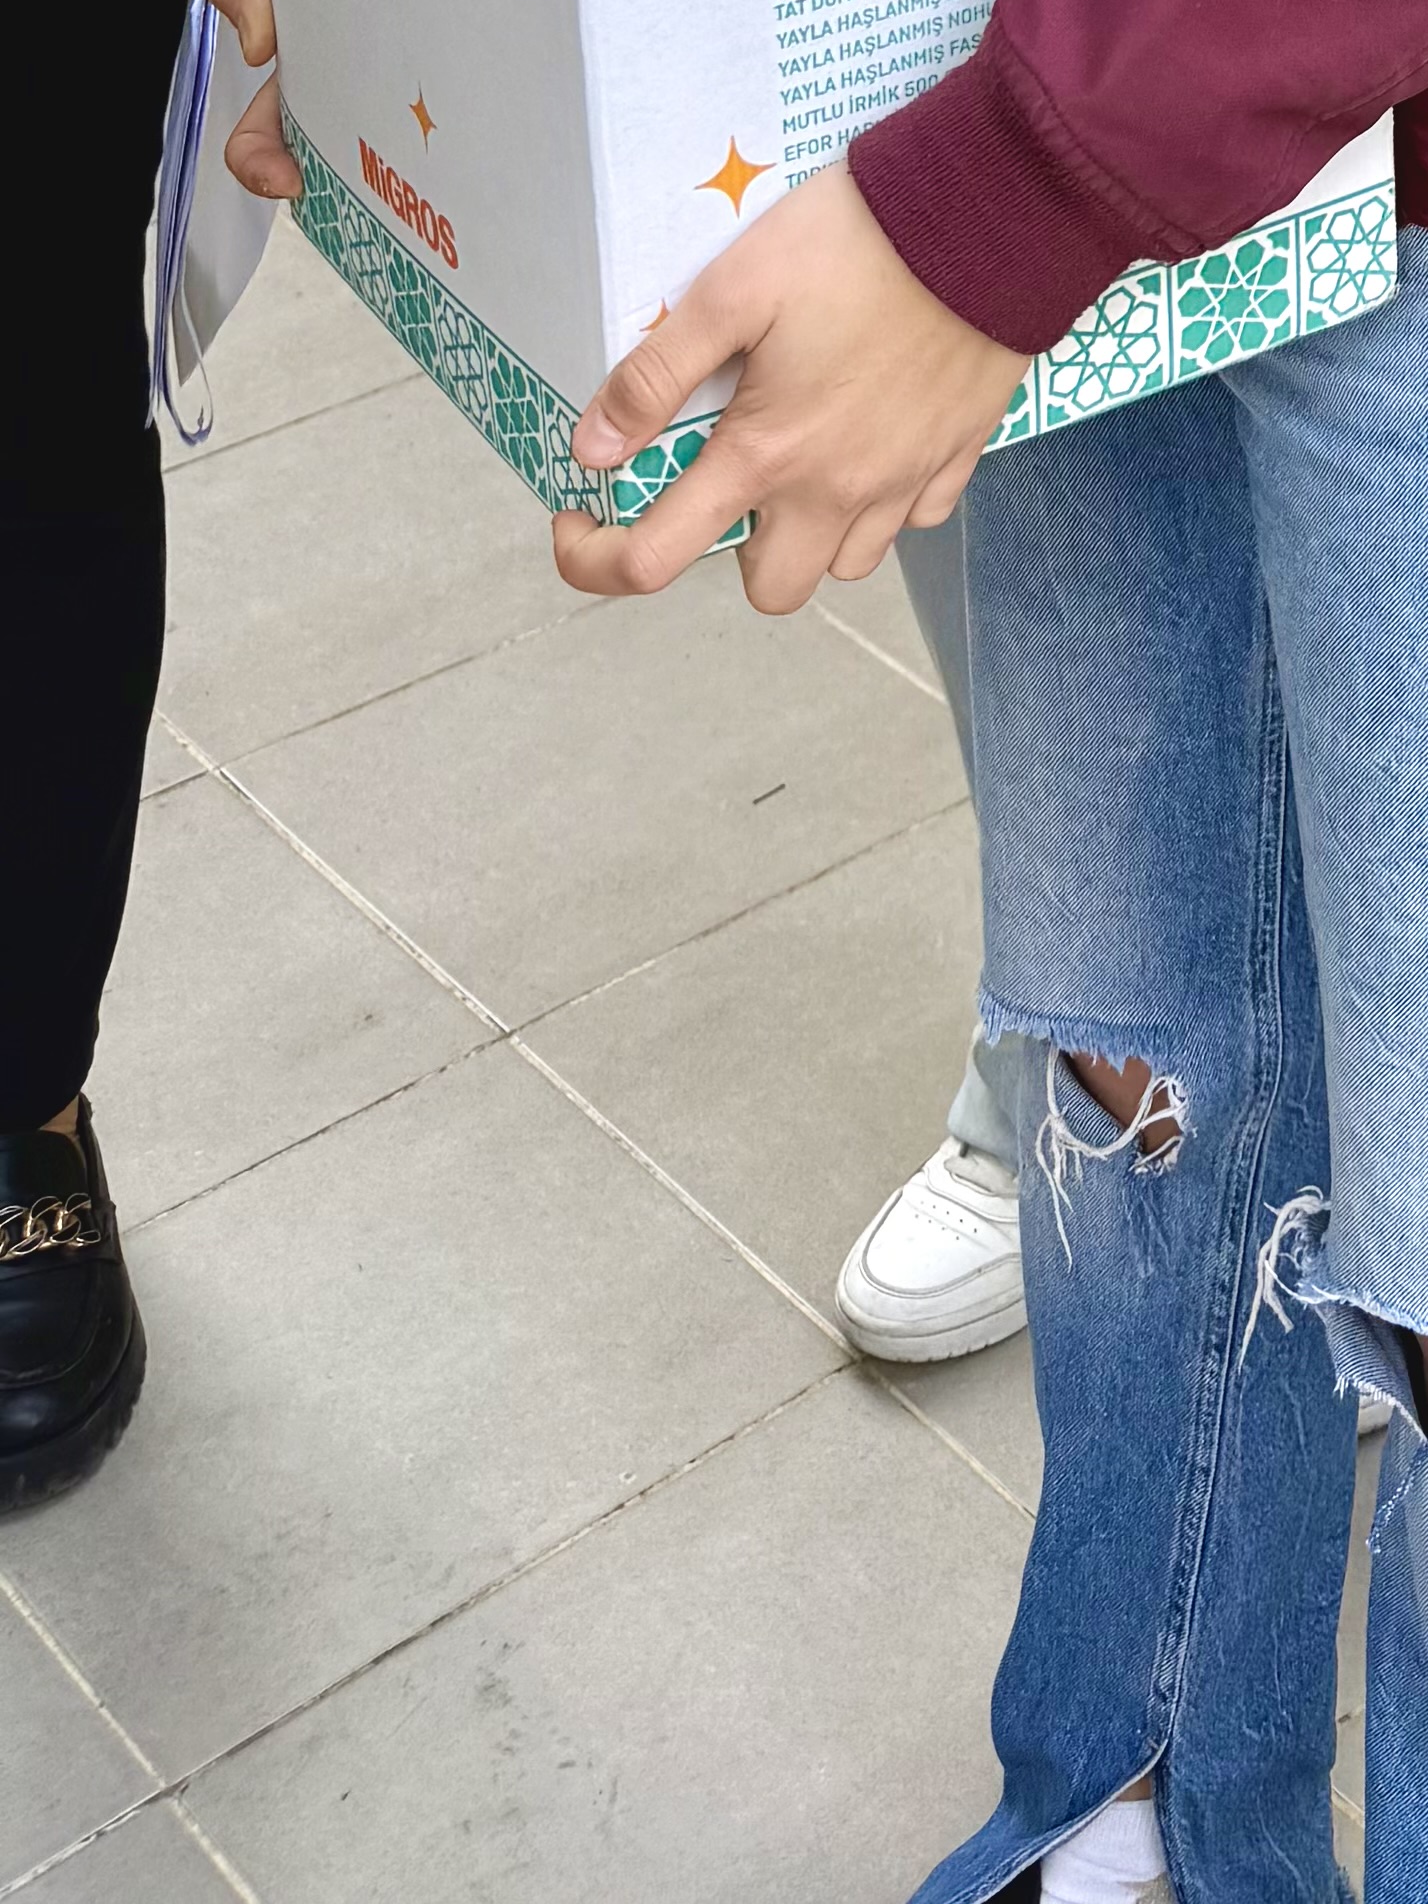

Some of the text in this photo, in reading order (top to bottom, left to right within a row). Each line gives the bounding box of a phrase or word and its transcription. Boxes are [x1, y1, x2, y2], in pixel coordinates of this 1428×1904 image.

[774, 0, 807, 21] TAT
[776, 21, 832, 49] YAYLA
[778, 49, 834, 78] YAYLA
[839, 17, 943, 59] HAŞLANMIŞ
[780, 77, 836, 106] YAYLA
[841, 45, 945, 88] HAŞLANMIŞ
[782, 103, 843, 134] MUTLU
[850, 84, 900, 114] İRMİK
[784, 135, 832, 163] EFOR
